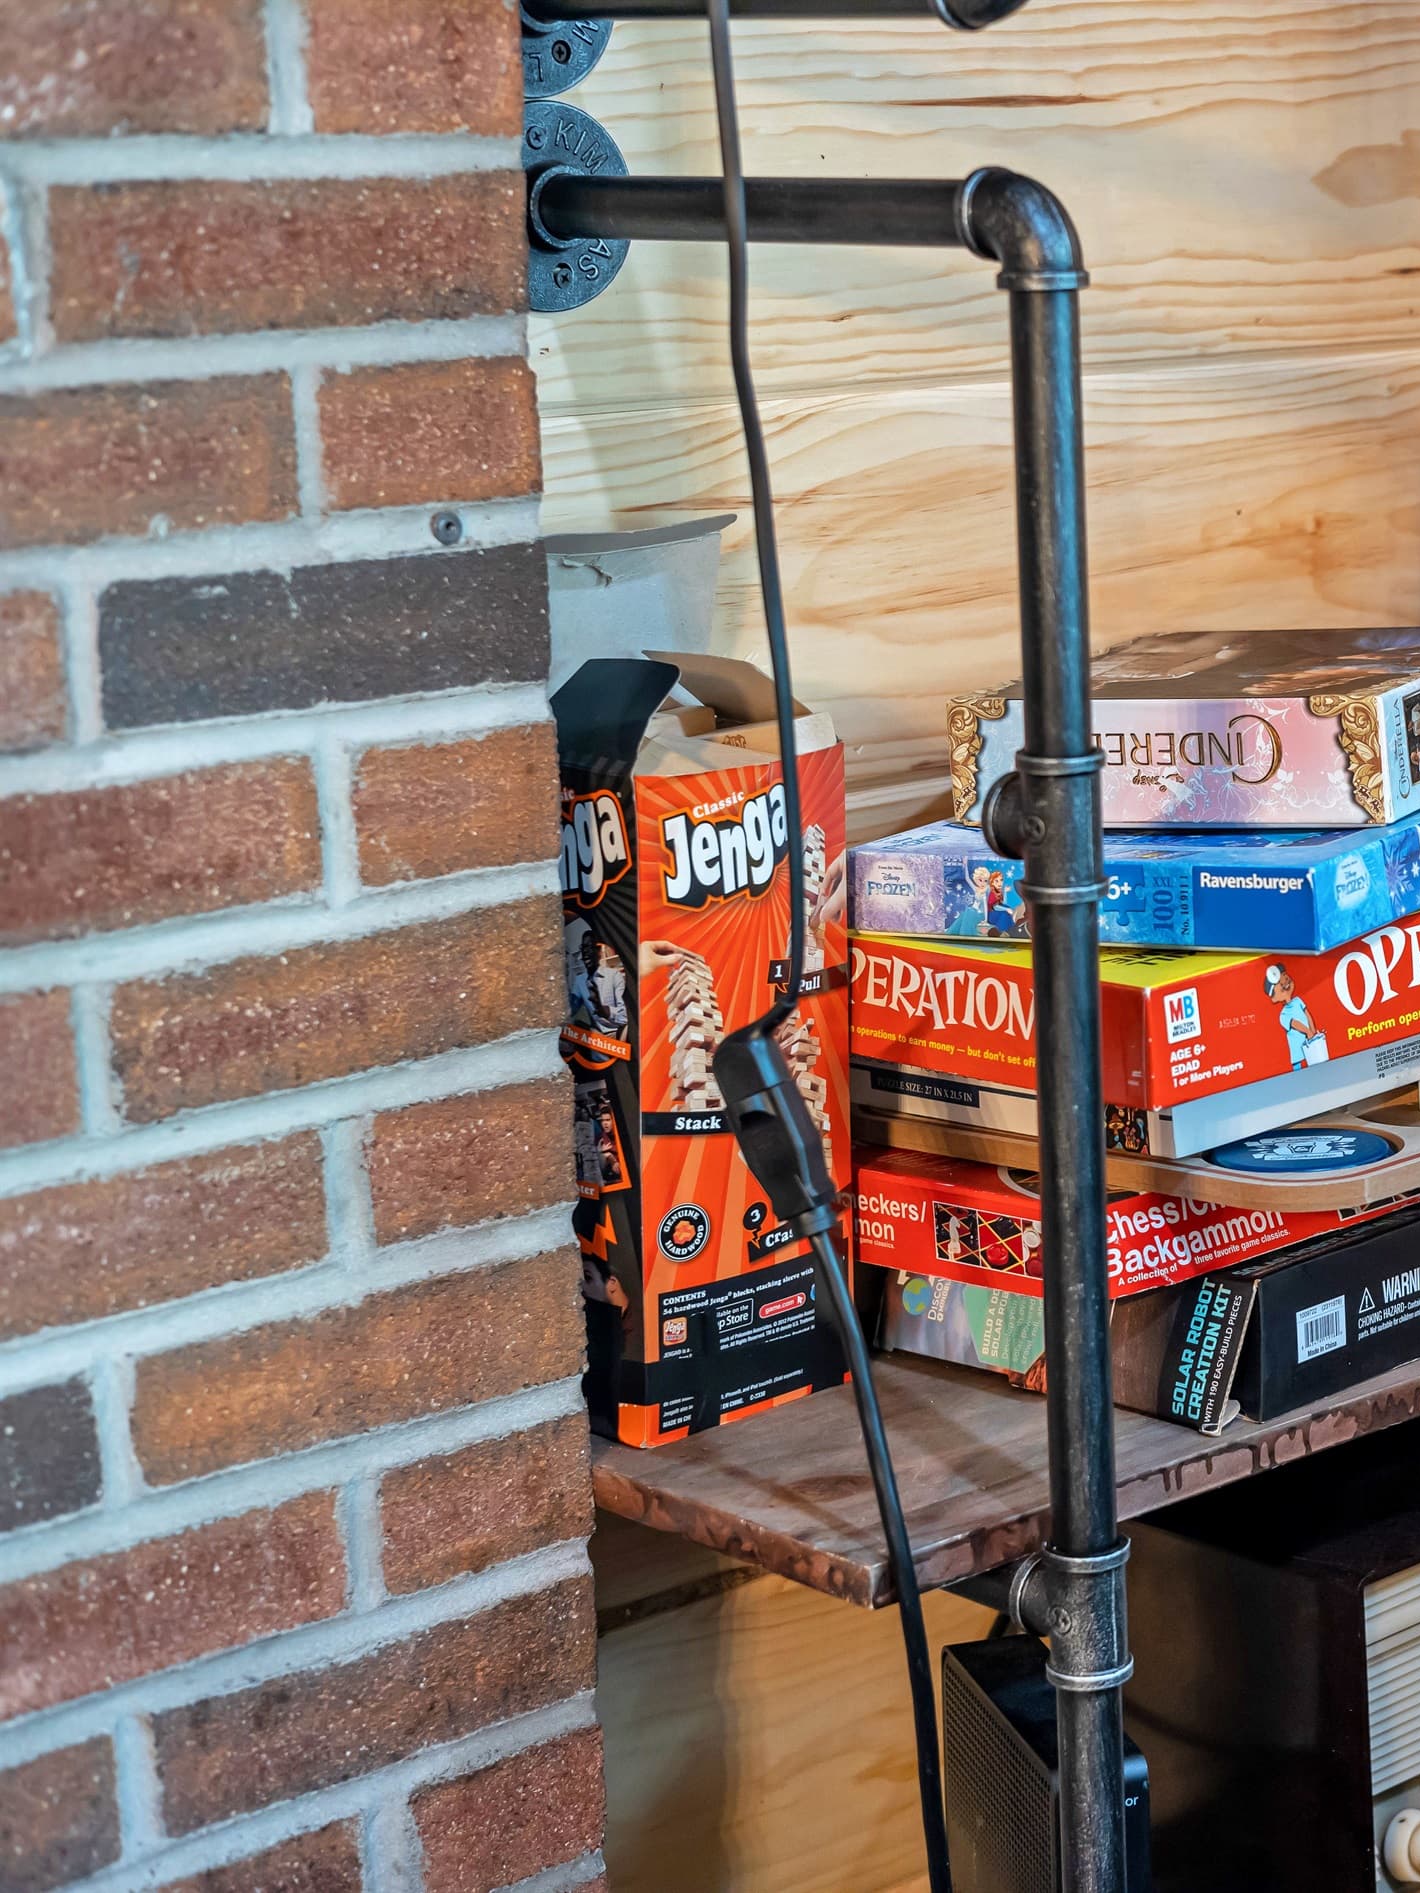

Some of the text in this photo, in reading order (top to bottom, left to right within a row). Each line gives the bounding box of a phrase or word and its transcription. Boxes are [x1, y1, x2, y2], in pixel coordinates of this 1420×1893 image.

[692, 790, 745, 819] Classic
[560, 796, 628, 894] nga
[664, 783, 789, 900] Jenga
[866, 880, 916, 897] FROZEN
[1106, 875, 1132, 900] 6+
[1199, 871, 1304, 894] Ravensburger
[1152, 889, 1174, 932] 100
[774, 964, 782, 978] 1
[1169, 995, 1195, 1023] MB
[1347, 1018, 1396, 1041] Perform
[581, 1032, 627, 1056] Architect
[856, 1026, 896, 1041] operations
[898, 1034, 907, 1043] to
[909, 1037, 927, 1047] earn
[929, 1040, 955, 1055] money
[967, 1046, 982, 1058] but
[983, 1049, 1005, 1062] don't
[1007, 1055, 1021, 1065] set
[1170, 1044, 1207, 1063] AGE 6+
[1171, 1059, 1200, 1077] EDAD
[1179, 1076, 1189, 1086] or
[1190, 1070, 1212, 1084] More
[1212, 1061, 1244, 1077] Players
[905, 1082, 923, 1094] SIZE:
[924, 1085, 933, 1095] 27
[674, 1115, 722, 1131] Stack
[750, 1208, 761, 1222] 3
[857, 1192, 927, 1223] eckers/
[663, 1209, 700, 1233] GENUINE
[664, 1224, 704, 1256] HARDWOOD
[765, 1229, 793, 1248] Cra
[1107, 1210, 1284, 1279] Backgammon
[1118, 1229, 1291, 1286] A collection of three favorite game classics.
[663, 1289, 706, 1306] CONTENTS
[674, 1299, 709, 1313] hardwood
[726, 1313, 749, 1325] Store
[1358, 1311, 1383, 1329] CHOKING
[981, 1318, 994, 1355] BUILD
[991, 1318, 1003, 1358] SOLAR
[1172, 1277, 1216, 1416] SOLAR ROBOT
[1187, 1283, 1232, 1420] CREATION KIT
[1204, 1295, 1243, 1423] WITH 190 EASY-BUILD PIECES
